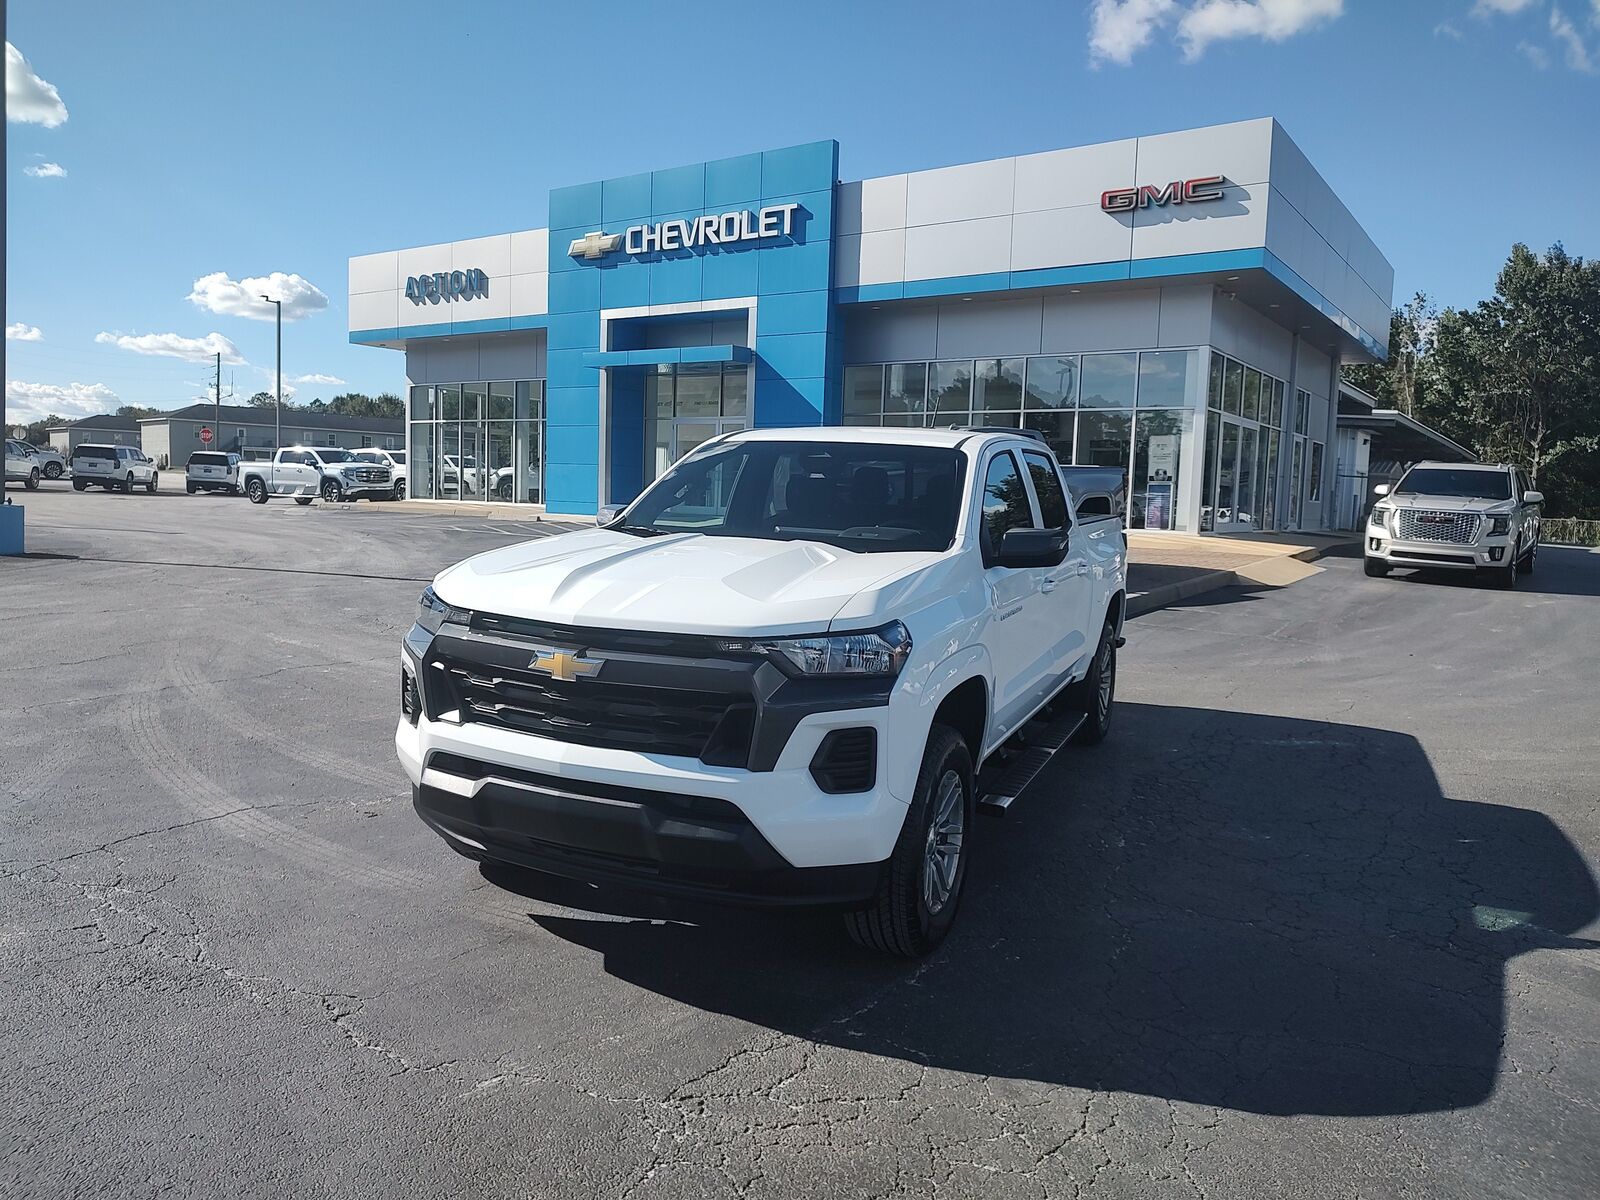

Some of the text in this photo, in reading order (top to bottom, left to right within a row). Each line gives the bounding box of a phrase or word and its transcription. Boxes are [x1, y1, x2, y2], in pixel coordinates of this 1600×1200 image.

[1100, 175, 1224, 212] GMC
[625, 203, 798, 254] CHEVROLET
[405, 268, 482, 298] ACTION
